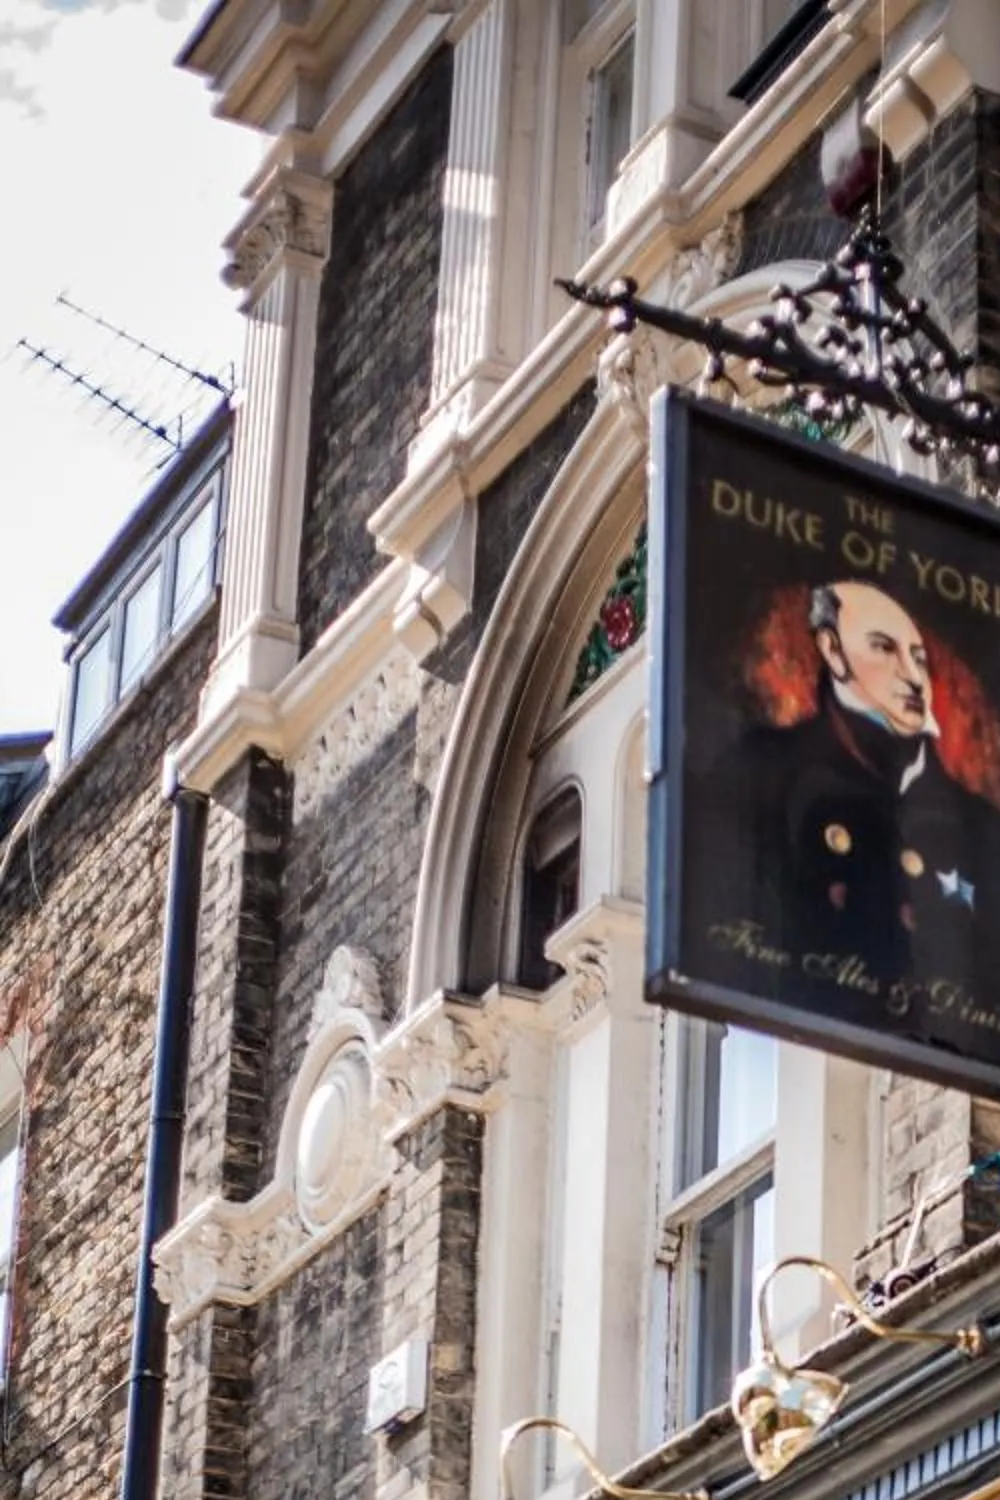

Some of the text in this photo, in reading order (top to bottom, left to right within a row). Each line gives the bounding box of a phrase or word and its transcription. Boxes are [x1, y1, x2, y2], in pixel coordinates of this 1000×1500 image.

[712, 479, 824, 549] DUKE
[841, 530, 897, 574] OF
[845, 496, 896, 534] THE
[707, 919, 791, 966] Fine
[802, 953, 880, 996] Ales
